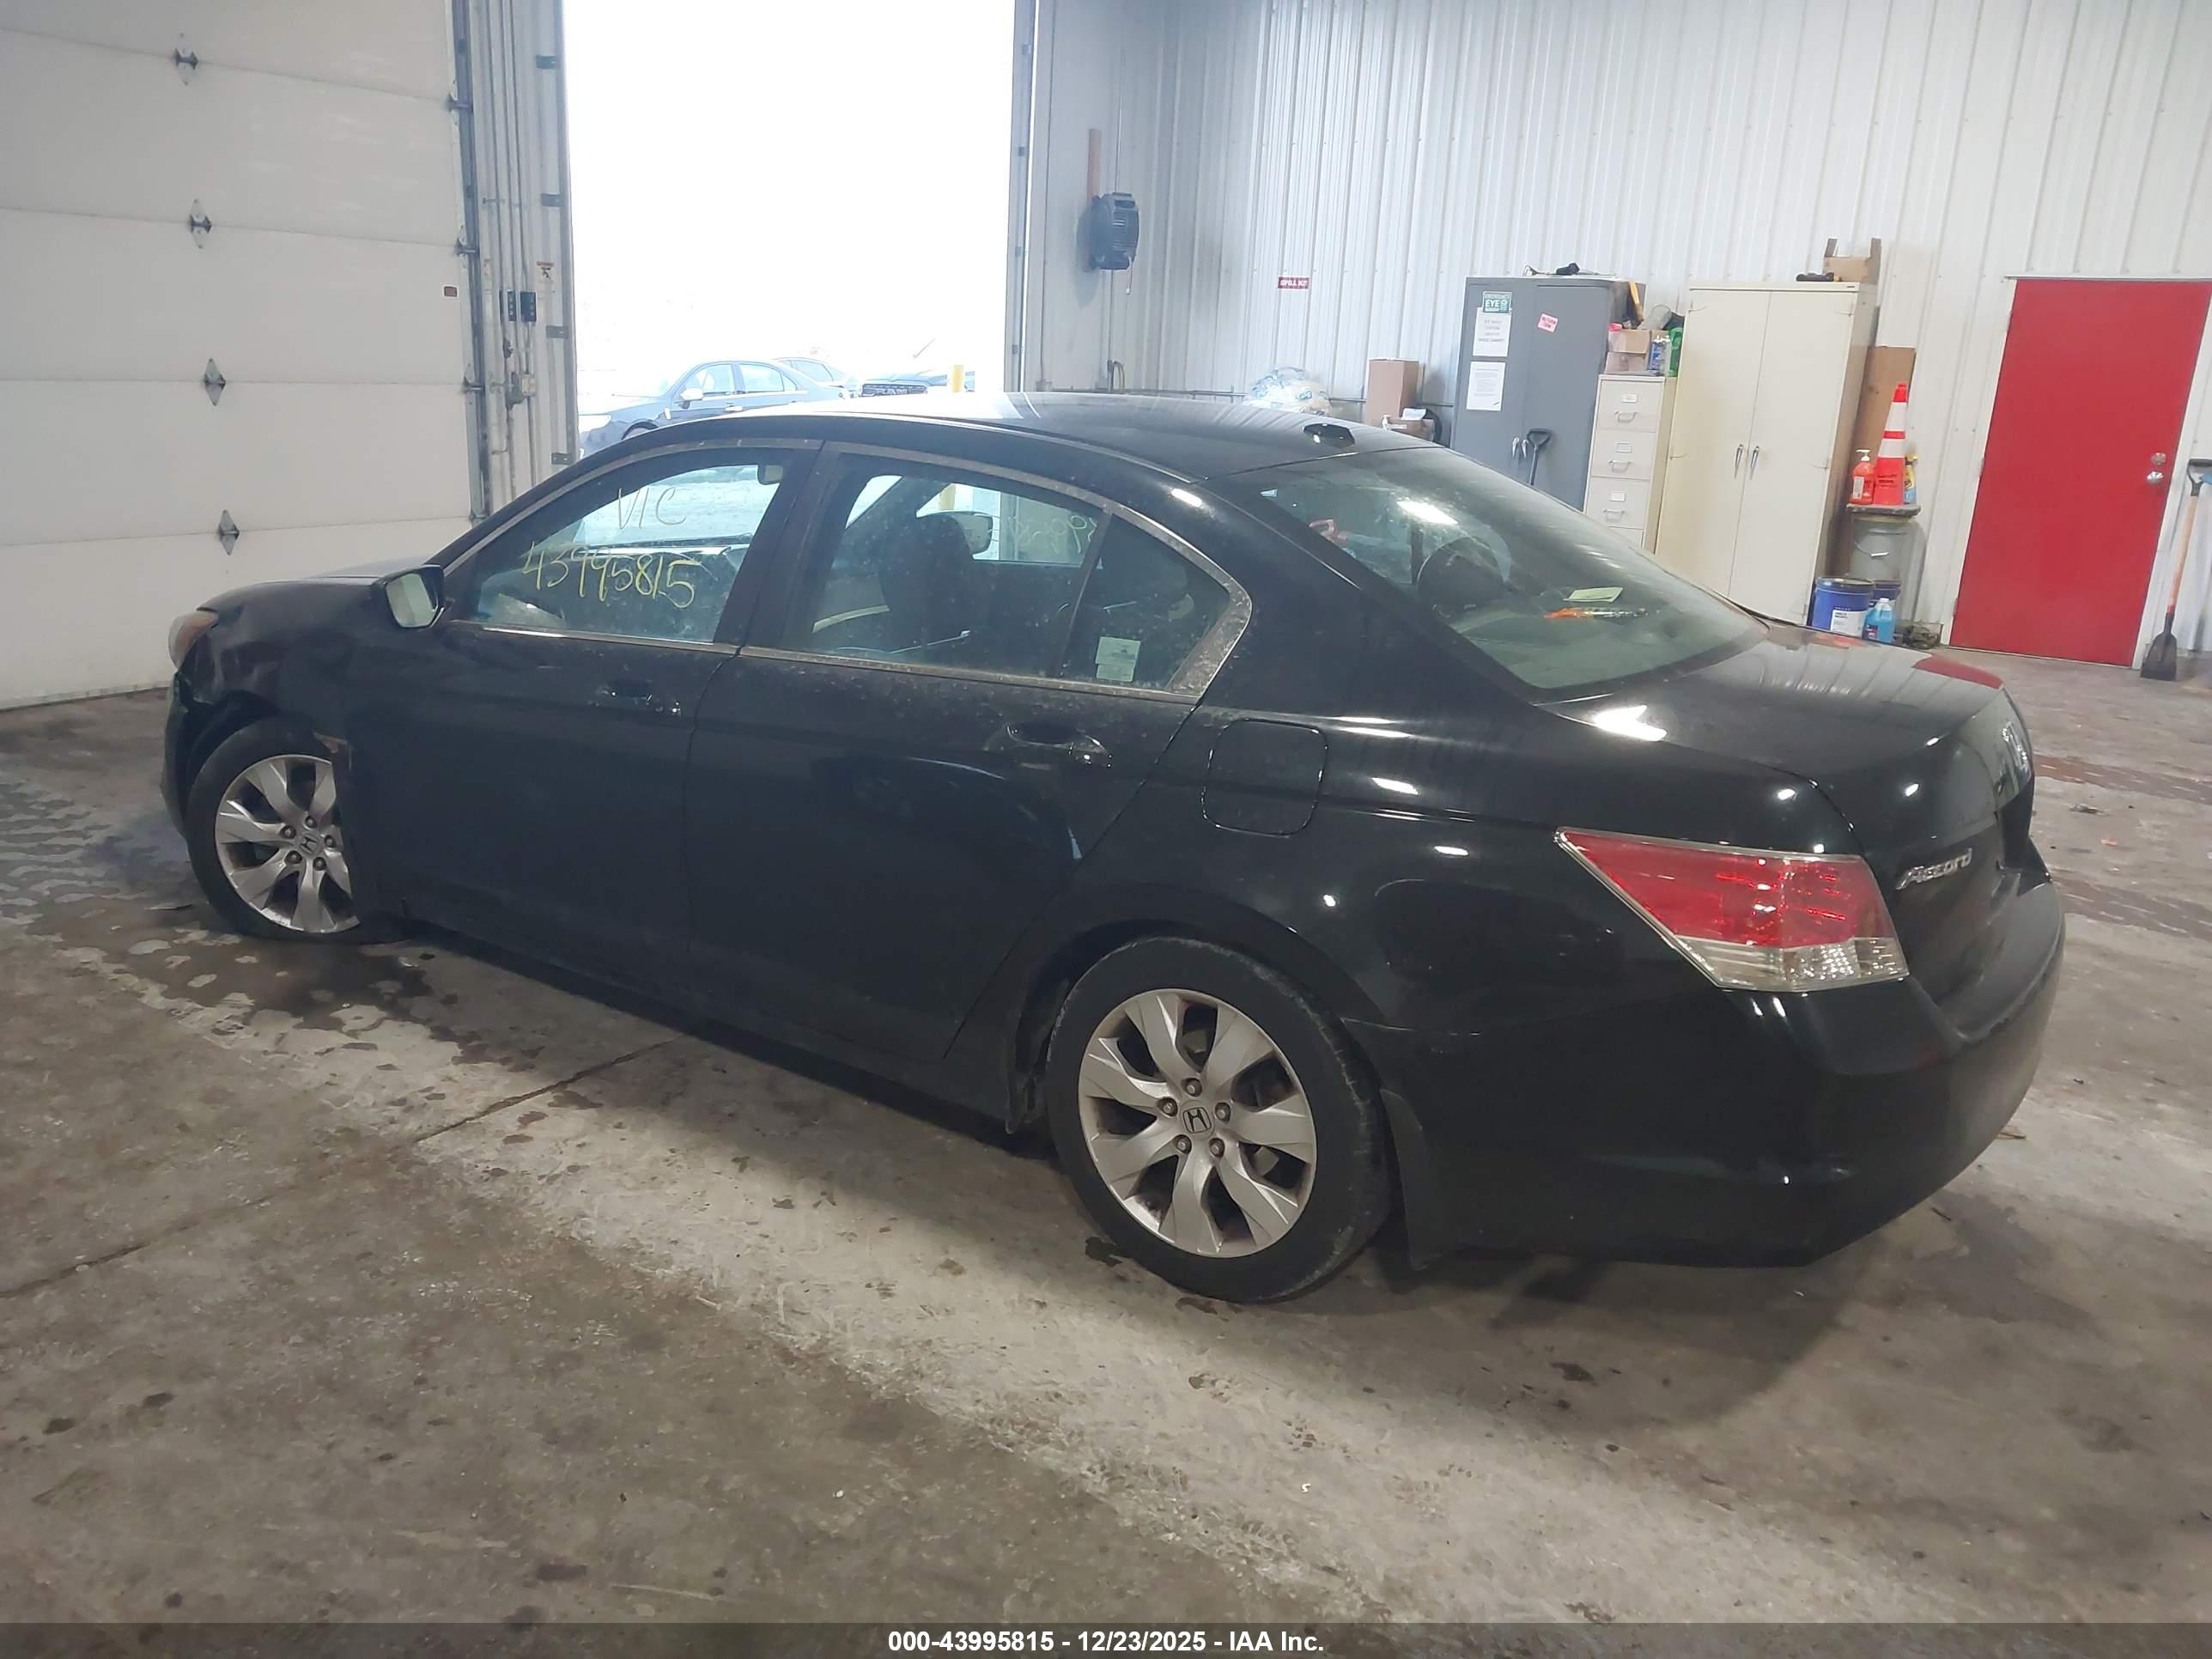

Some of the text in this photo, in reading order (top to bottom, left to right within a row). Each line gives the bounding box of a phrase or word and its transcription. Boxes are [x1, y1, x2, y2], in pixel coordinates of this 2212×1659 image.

[1485, 299, 1500, 307] EYE
[617, 486, 687, 529] VIC
[522, 541, 702, 609] 43995815
[1895, 847, 1973, 890] Accord
